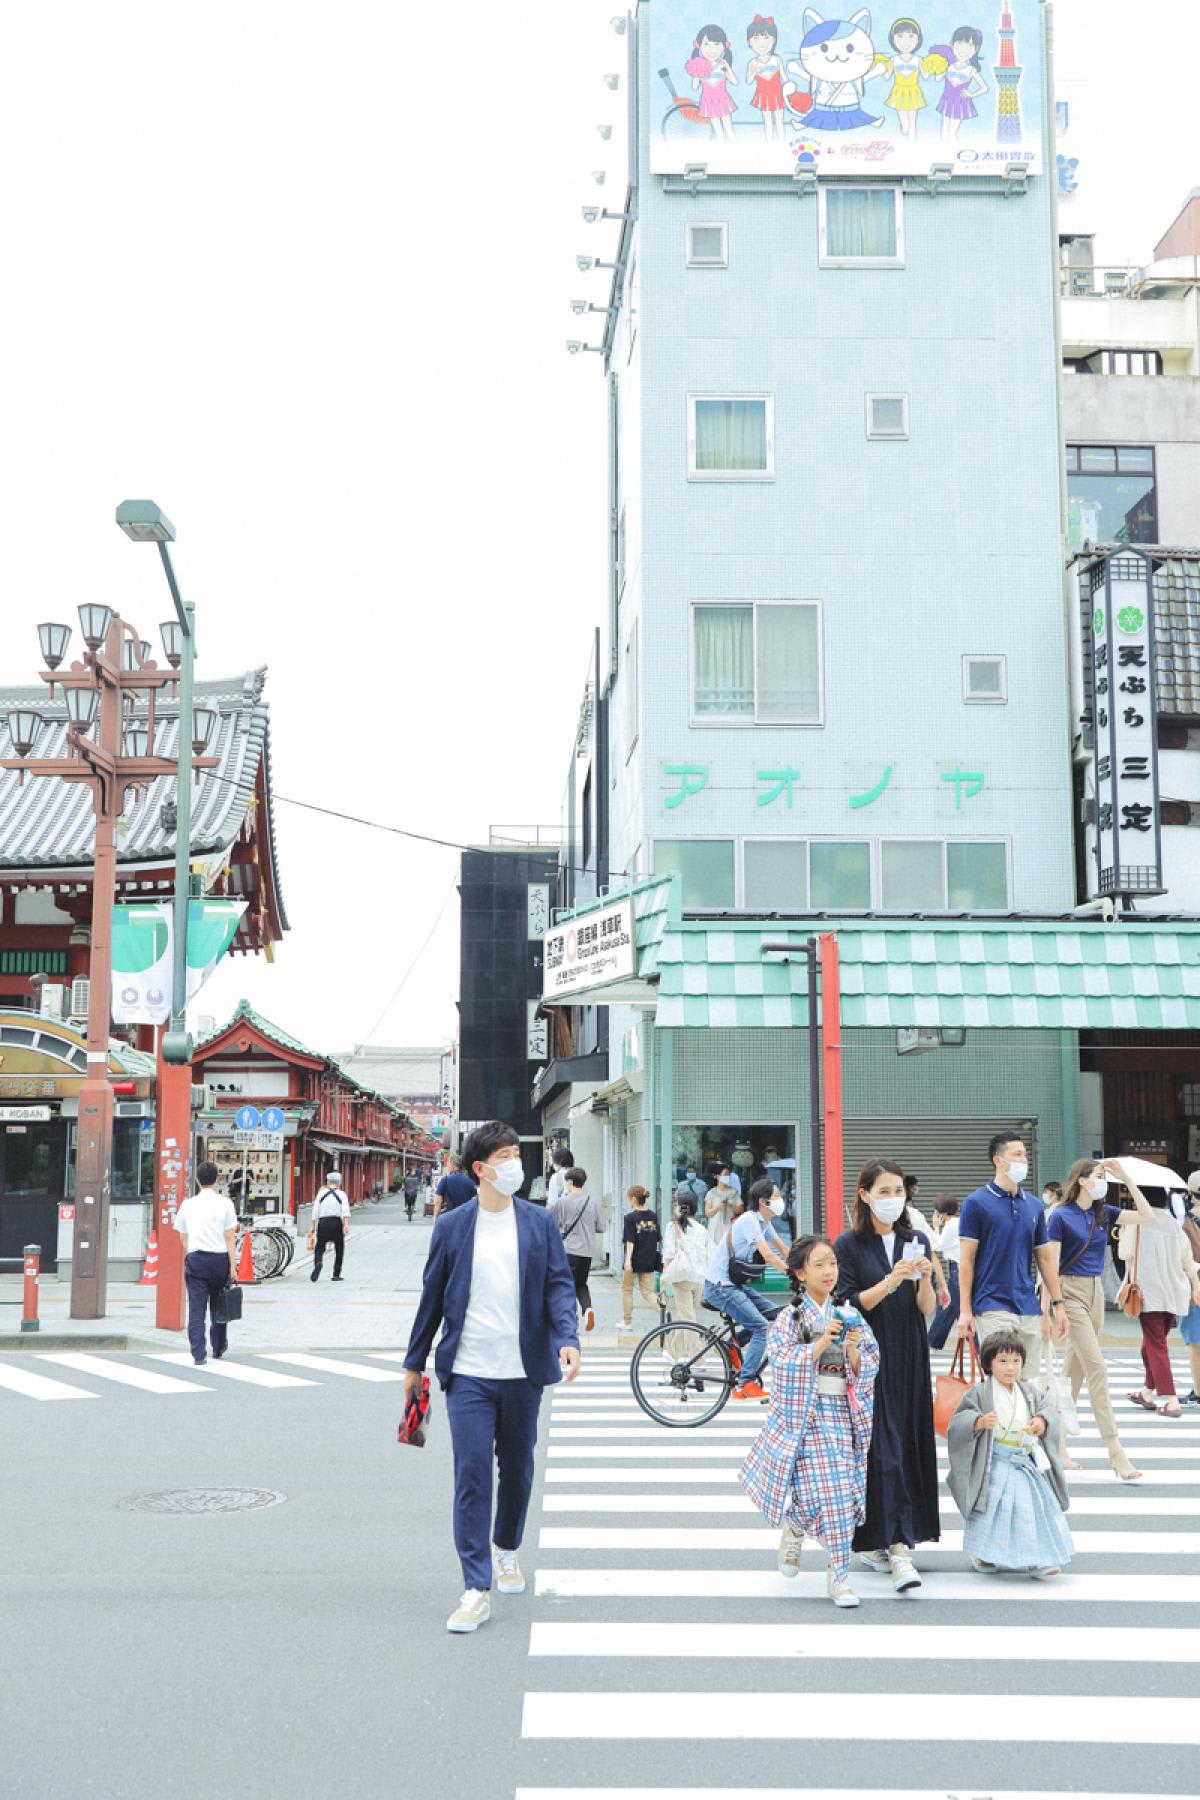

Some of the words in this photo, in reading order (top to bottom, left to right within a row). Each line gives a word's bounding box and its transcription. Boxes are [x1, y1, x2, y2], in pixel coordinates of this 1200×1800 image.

[664, 765, 985, 810] アオノヤ
[0, 1081, 56, 1096] 門交番
[9, 1109, 43, 1118] KOBAN
